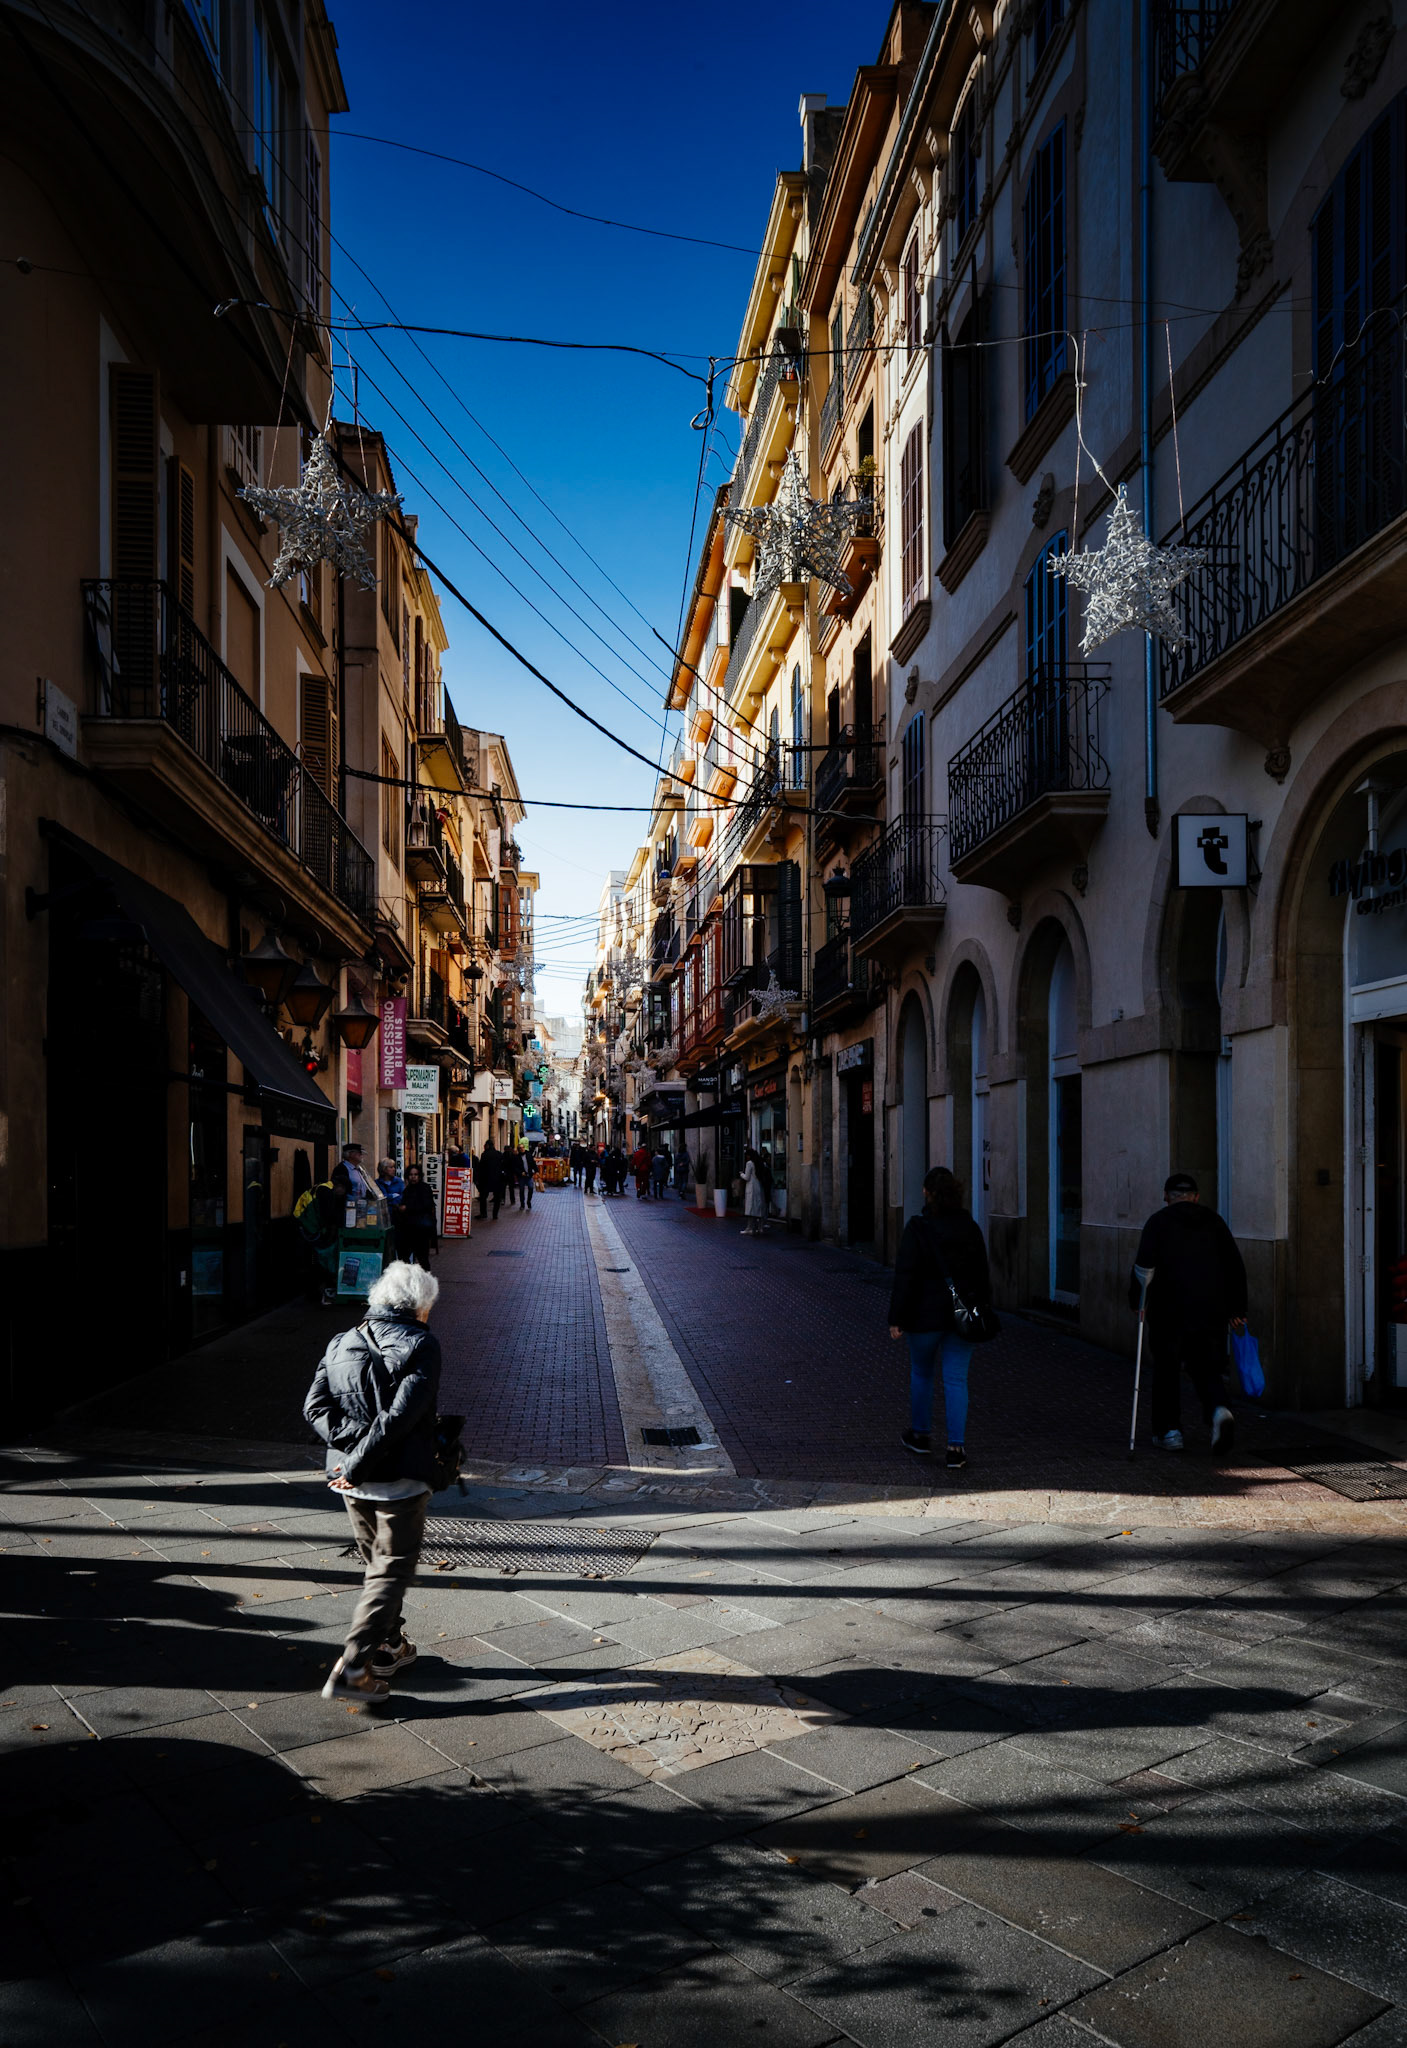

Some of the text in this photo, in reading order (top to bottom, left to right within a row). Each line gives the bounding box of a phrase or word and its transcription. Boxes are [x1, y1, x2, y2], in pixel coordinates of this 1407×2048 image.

[384, 1000, 395, 1085] PRINCESSRIO
[394, 1018, 403, 1068] BIKINIS
[446, 1204, 461, 1214] FAX
